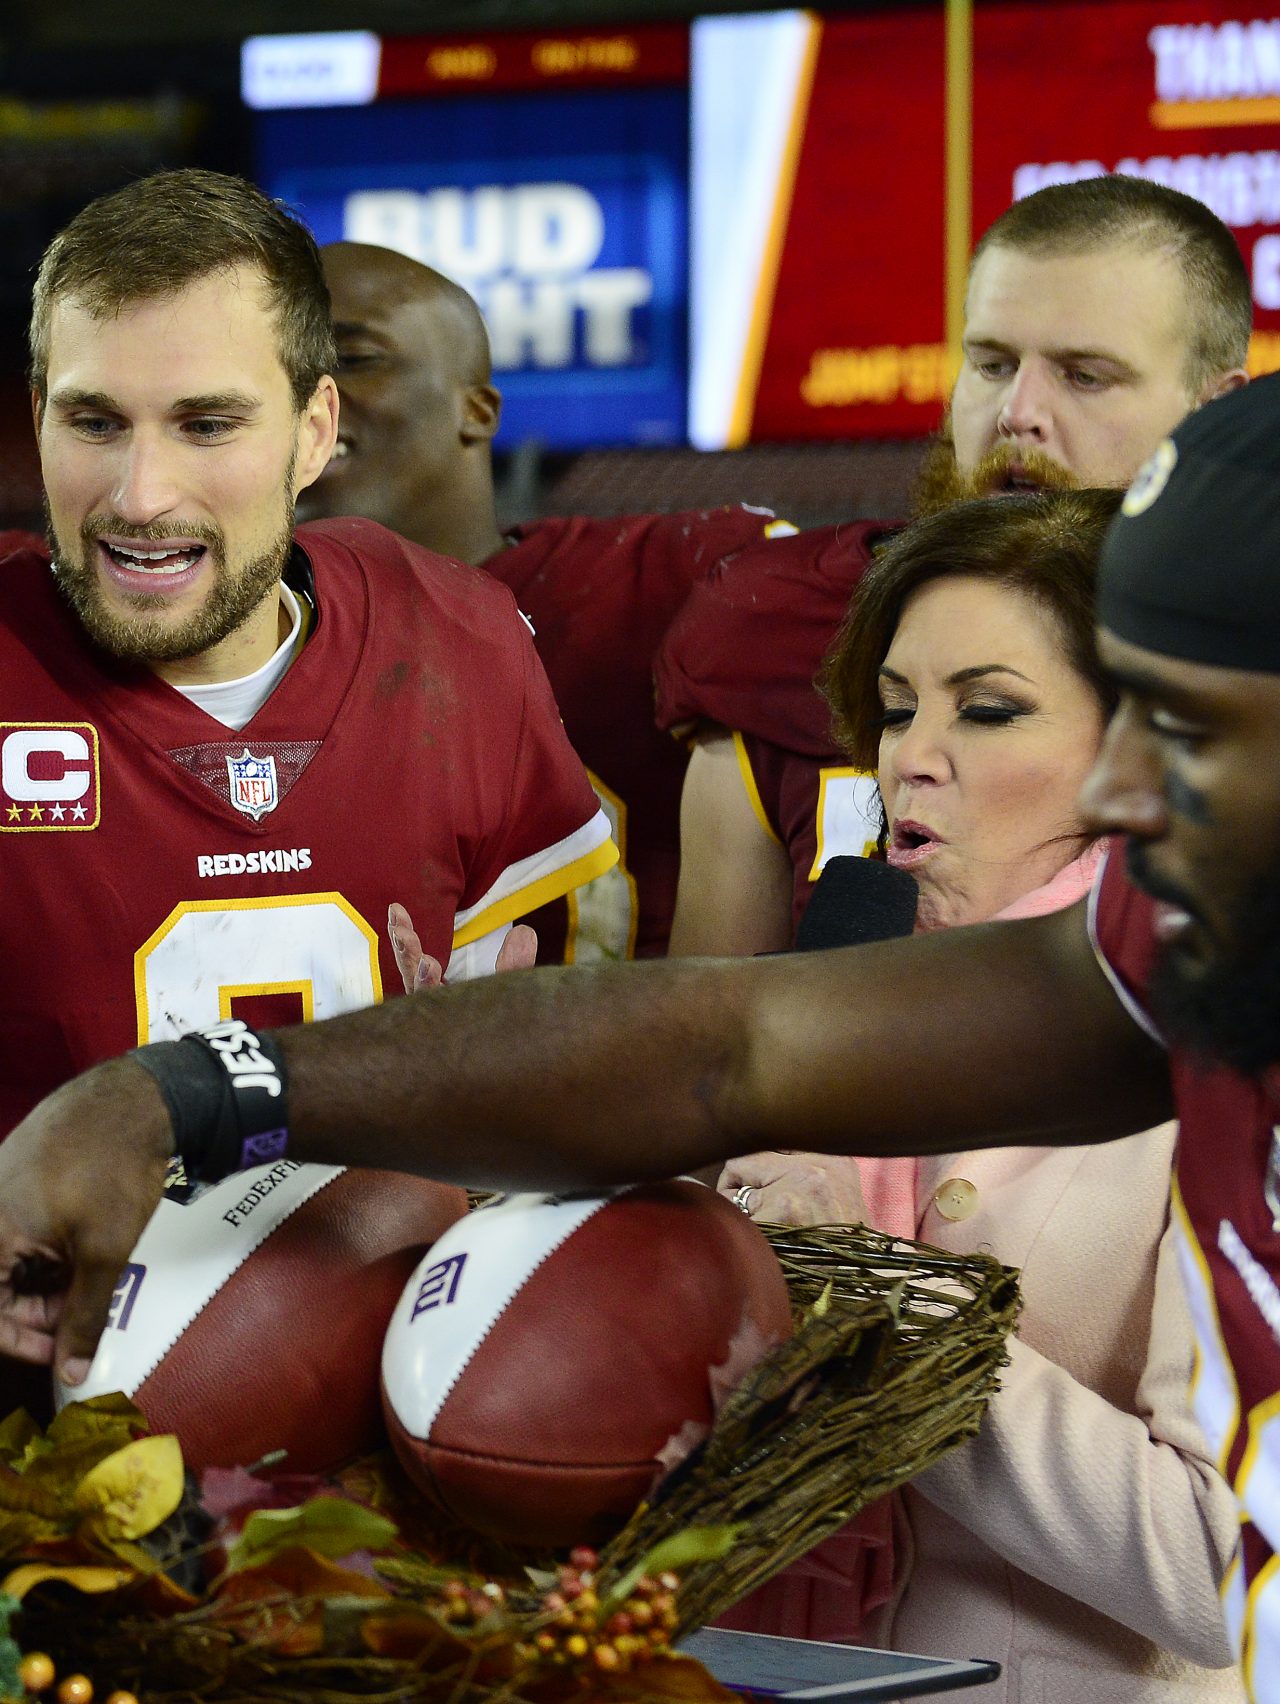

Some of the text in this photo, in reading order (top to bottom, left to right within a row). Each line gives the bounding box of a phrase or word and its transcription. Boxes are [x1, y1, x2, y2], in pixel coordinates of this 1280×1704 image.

[342, 182, 605, 276] BUD
[1, 730, 90, 801] C
[238, 779, 271, 804] NFL
[197, 848, 313, 878] REDSKINS
